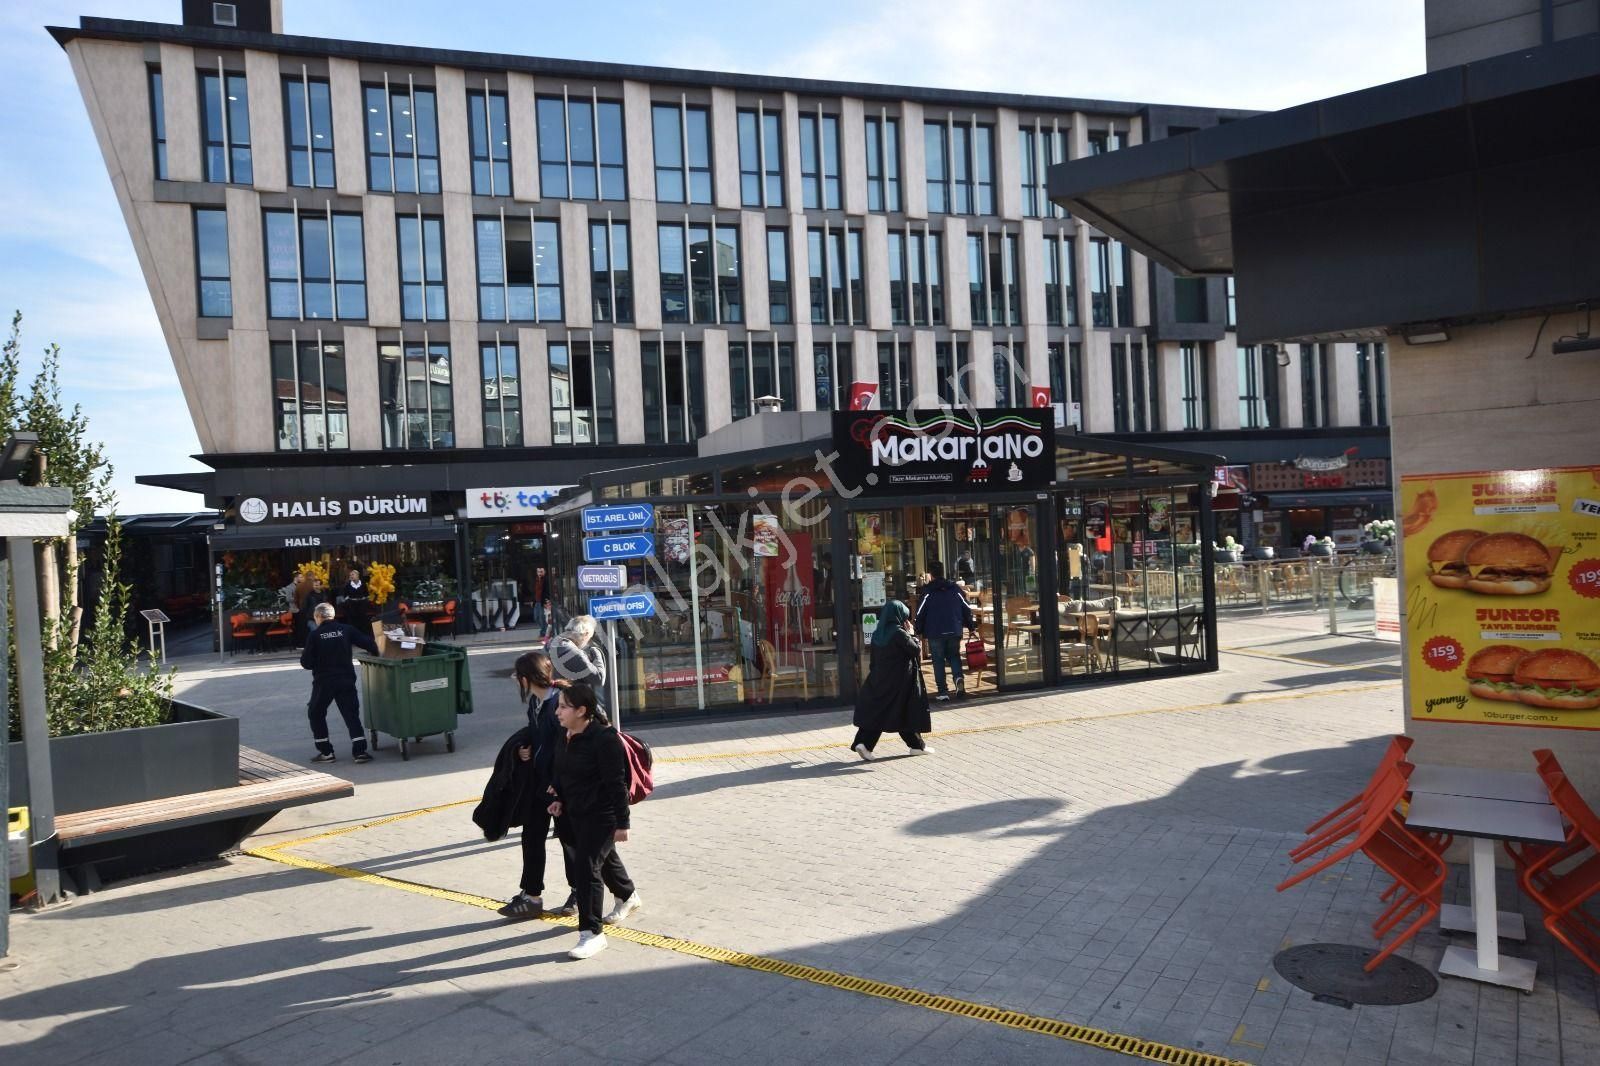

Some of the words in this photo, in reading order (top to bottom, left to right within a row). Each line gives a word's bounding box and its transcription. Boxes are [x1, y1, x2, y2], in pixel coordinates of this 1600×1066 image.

[272, 497, 342, 518] HALİS
[349, 495, 427, 515] DÜRÜM
[605, 514, 627, 523] AREL
[285, 536, 321, 547] HALİS
[355, 533, 398, 544] DÜRÜM
[603, 544, 611, 553] C
[612, 542, 637, 552] BLOK
[582, 572, 618, 583] METROBÜS
[1475, 608, 1560, 622] JUNIOR
[1425, 695, 1469, 713] yummy
[1483, 711, 1559, 722] 10burger.com.tr
